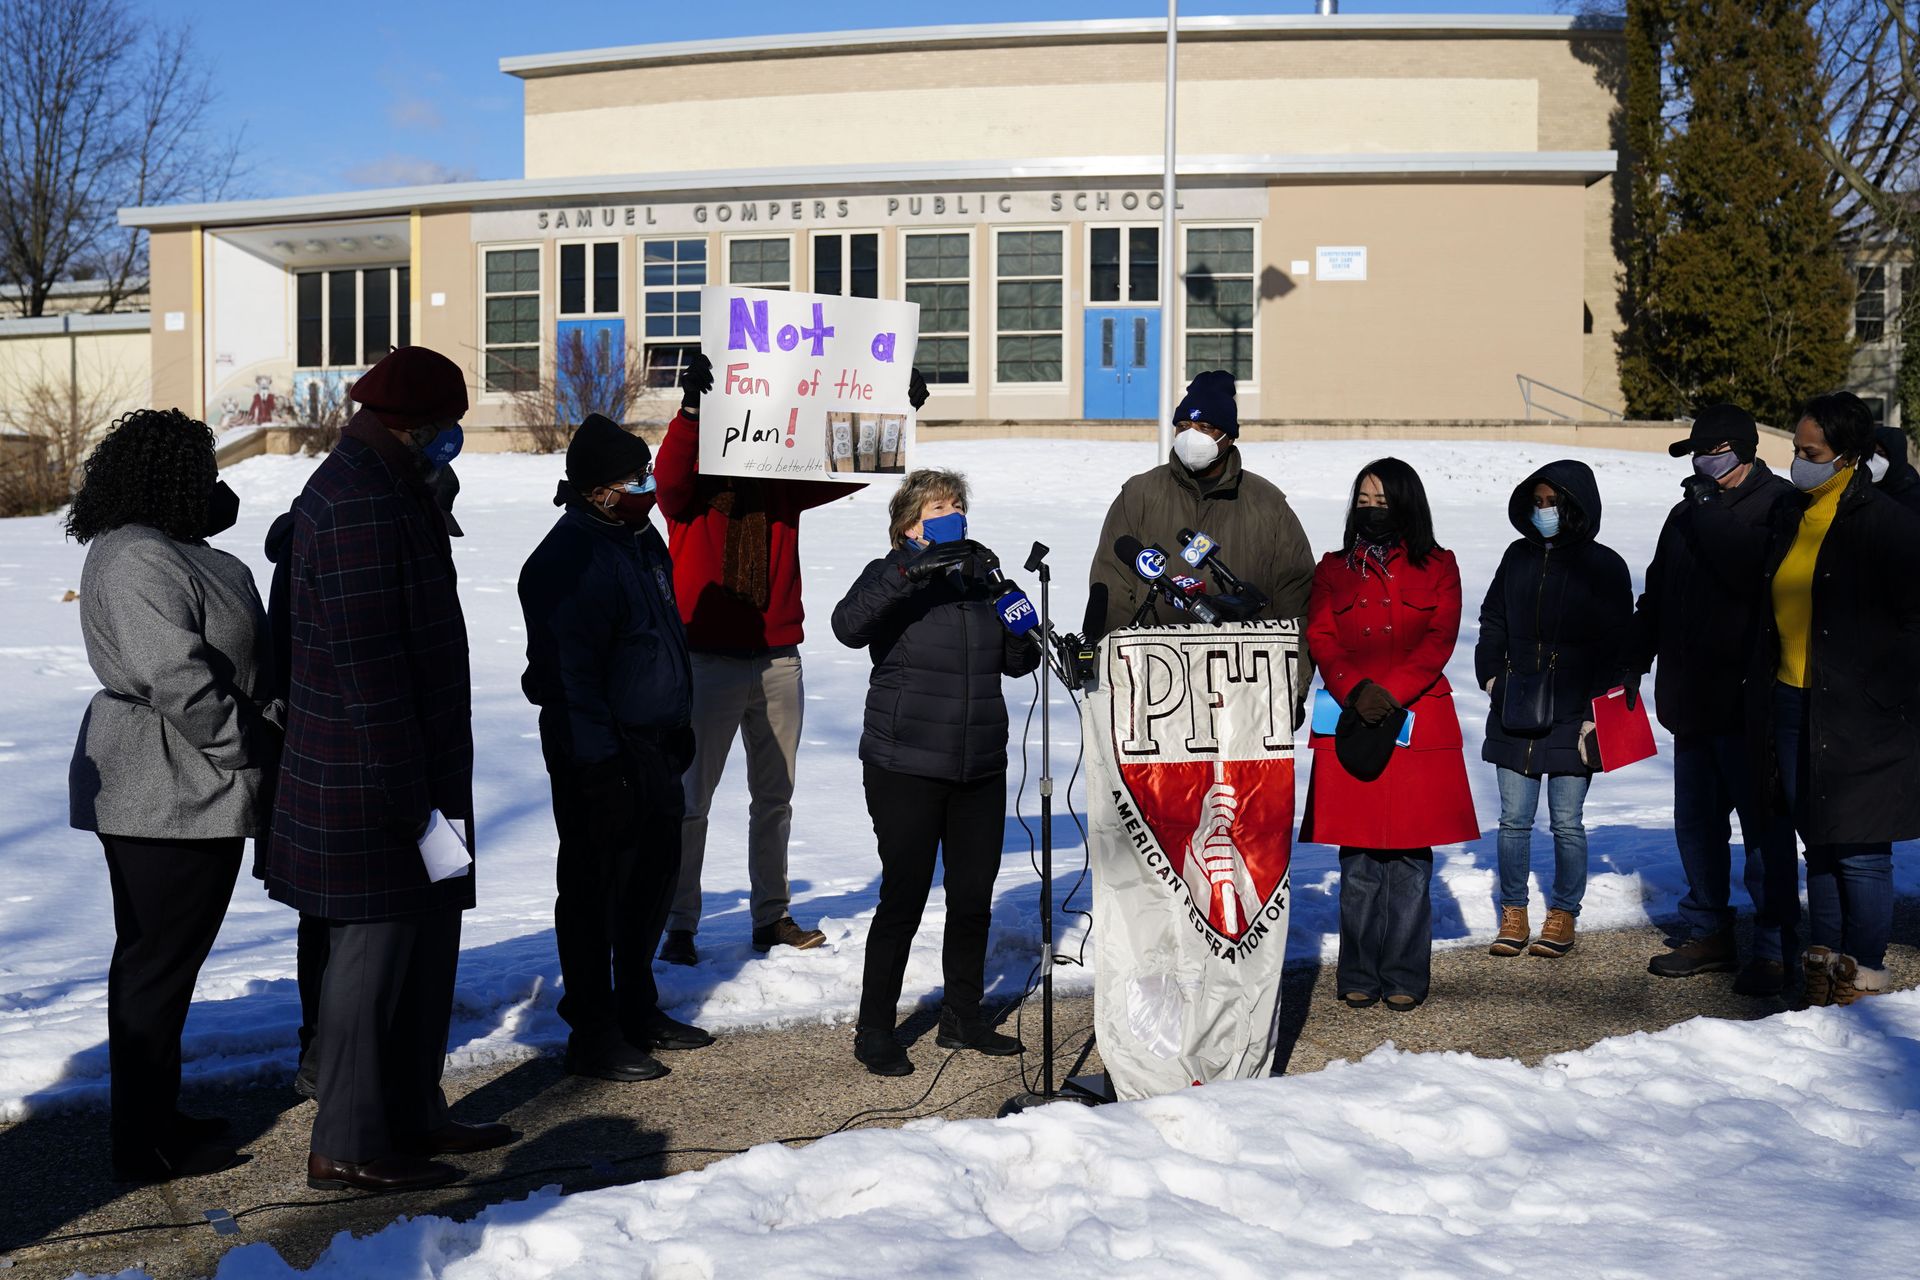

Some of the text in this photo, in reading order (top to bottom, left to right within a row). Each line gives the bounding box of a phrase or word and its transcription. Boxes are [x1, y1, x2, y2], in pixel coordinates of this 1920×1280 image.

[538, 190, 1184, 229] SAMUEL GOMPERS PUBLIC SCHOOL
[728, 297, 896, 363] Not a
[725, 363, 873, 400] Fan of the
[722, 408, 799, 457] plan!
[1193, 536, 1211, 553] 3
[1117, 641, 1299, 755] PFT
[1112, 790, 1182, 893] AMERICAN
[1184, 895, 1269, 964] FEDERATION
[1266, 893, 1285, 920] OF
